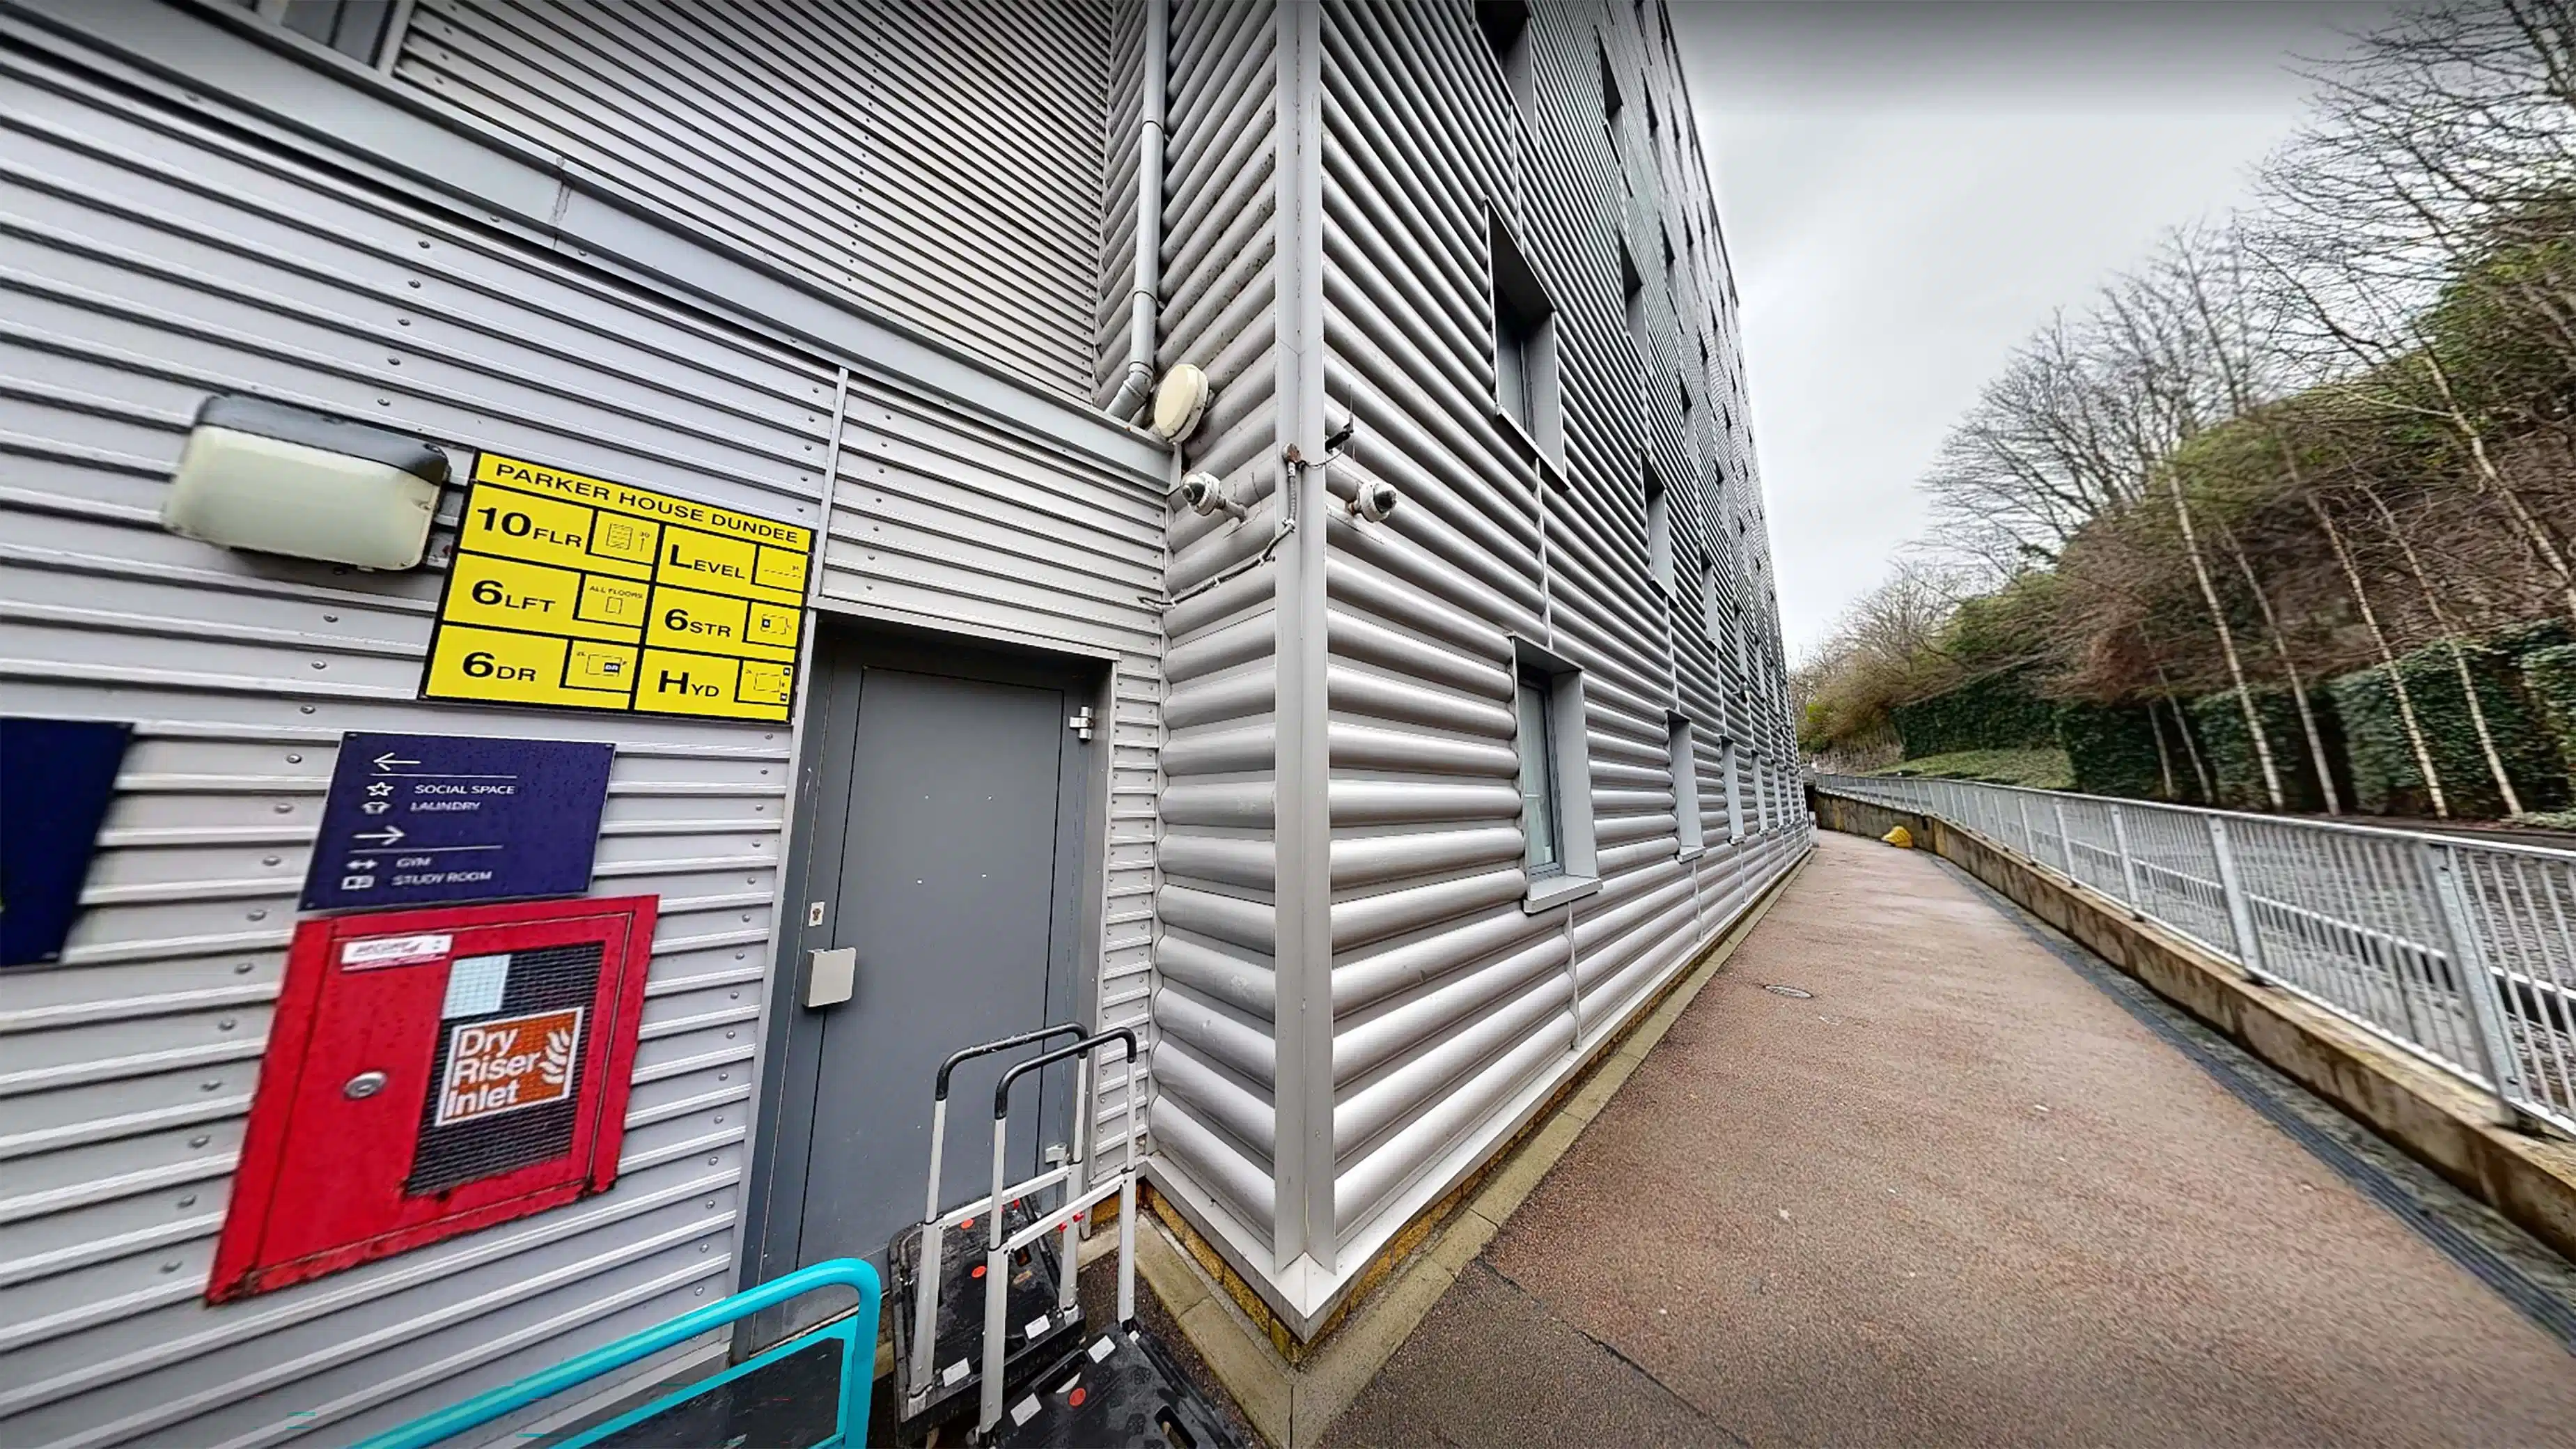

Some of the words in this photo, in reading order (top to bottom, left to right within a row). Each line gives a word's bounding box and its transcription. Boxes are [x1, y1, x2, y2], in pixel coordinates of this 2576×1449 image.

[496, 463, 610, 501] PARKER
[618, 492, 703, 522] HOUSE
[711, 513, 797, 543] DUNDEE
[589, 585, 606, 594] ALL
[608, 588, 643, 599] FLOORS
[414, 784, 468, 794] SOCIAL
[471, 785, 516, 795] SPACE
[409, 802, 481, 812] LAUNDRY
[395, 857, 432, 868] GYM
[391, 873, 446, 886] STUDY
[446, 871, 493, 883] ROOM
[458, 1028, 519, 1058] Dry
[451, 1051, 542, 1087] Riser
